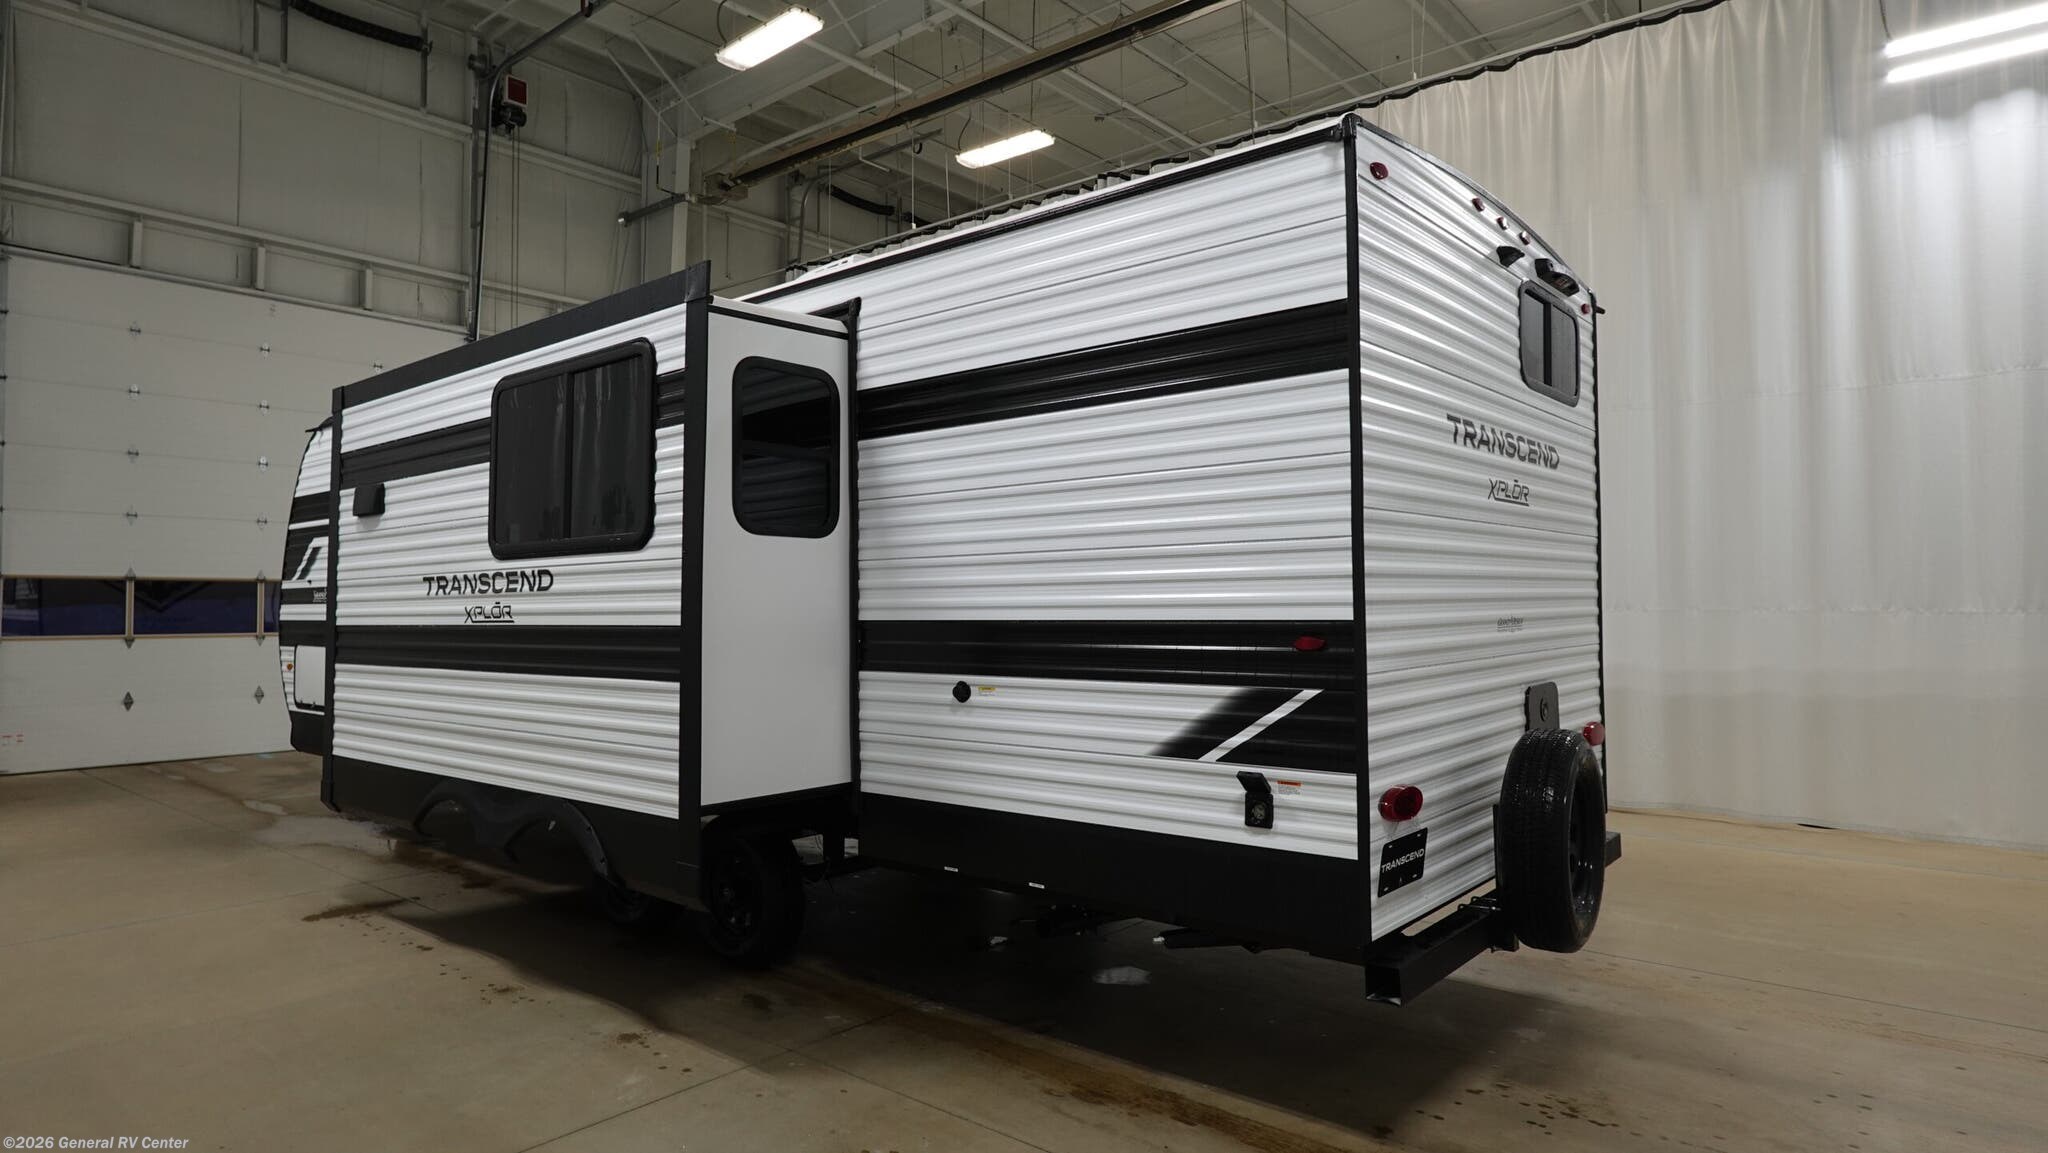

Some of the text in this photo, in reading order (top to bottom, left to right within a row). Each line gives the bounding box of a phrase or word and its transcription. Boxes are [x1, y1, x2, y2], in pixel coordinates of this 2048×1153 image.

[1446, 413, 1560, 470] TRANSCEND
[422, 569, 554, 596] TRANSCEND
[1381, 848, 1425, 873] TRANSCEND
